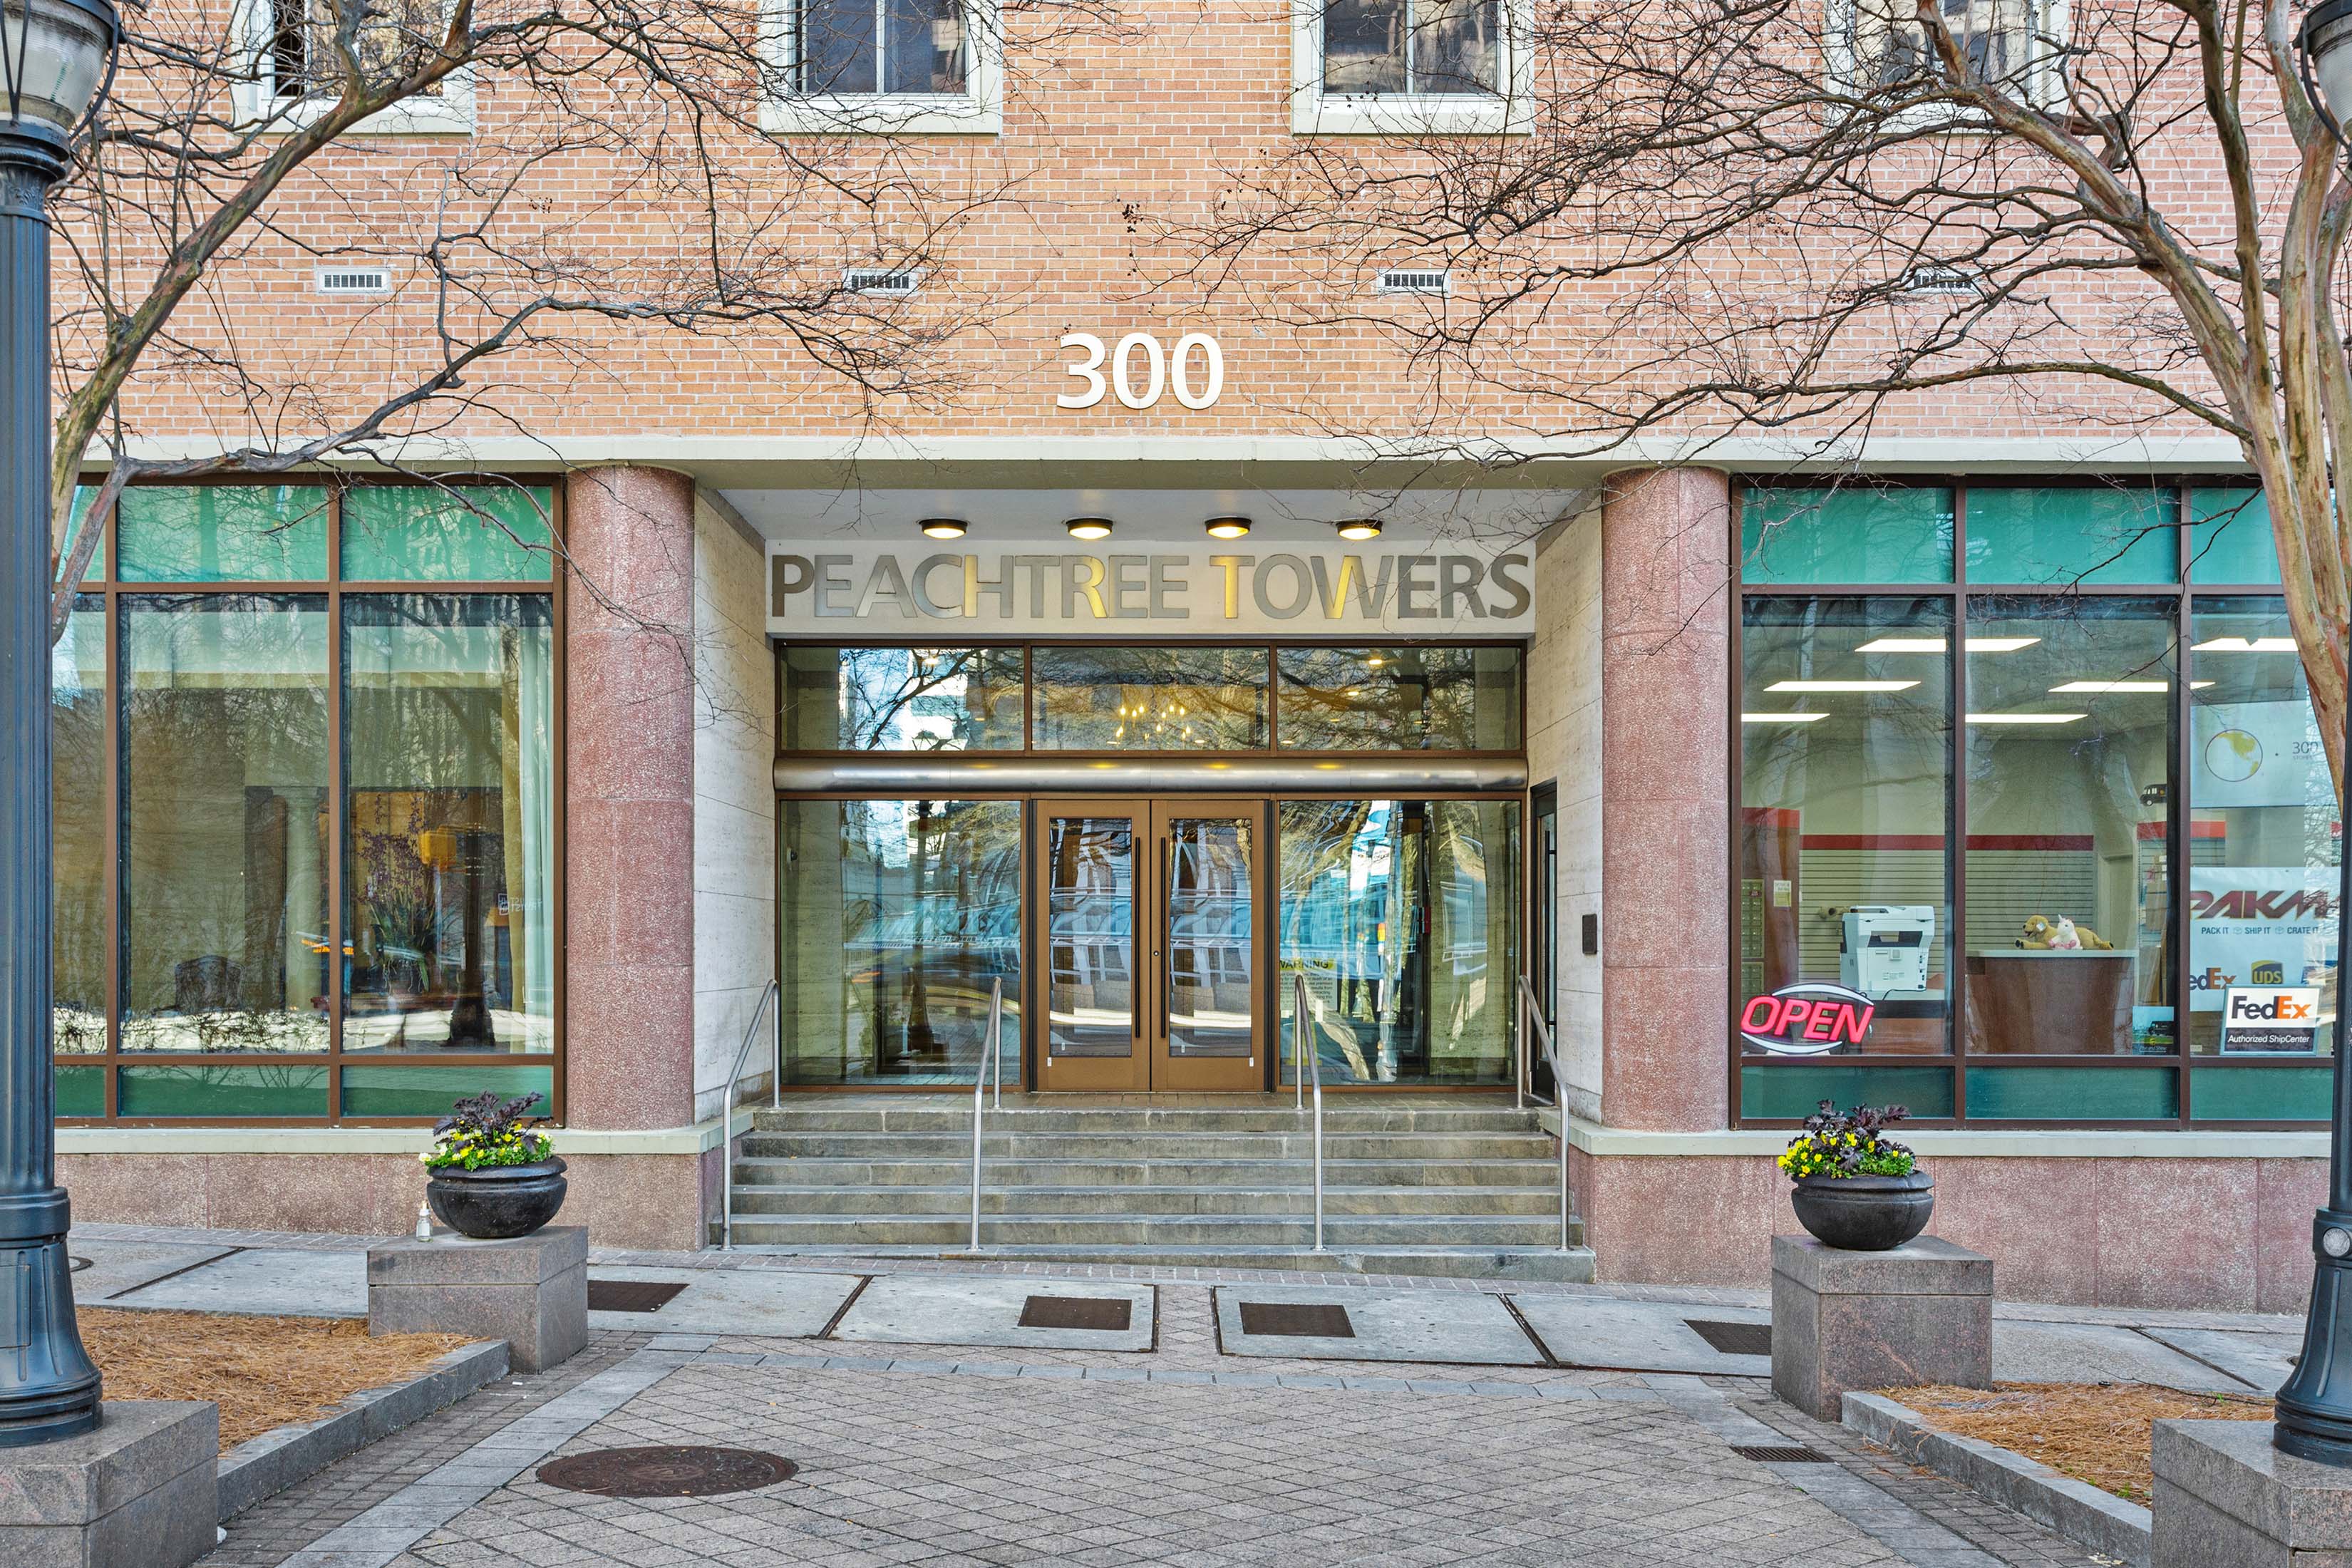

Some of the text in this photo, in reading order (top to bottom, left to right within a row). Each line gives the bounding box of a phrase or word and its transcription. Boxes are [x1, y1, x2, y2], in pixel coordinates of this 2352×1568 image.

[1057, 332, 1224, 410] 300
[771, 554, 1531, 619] PEACHTREE TOWERS
[2292, 741, 2319, 754] 300
[2190, 890, 2340, 920] PAKM
[1740, 996, 1874, 1043] OPEN
[2232, 996, 2311, 1019] FedEx
[2227, 1035, 2310, 1044] Authorized ShipCenter
